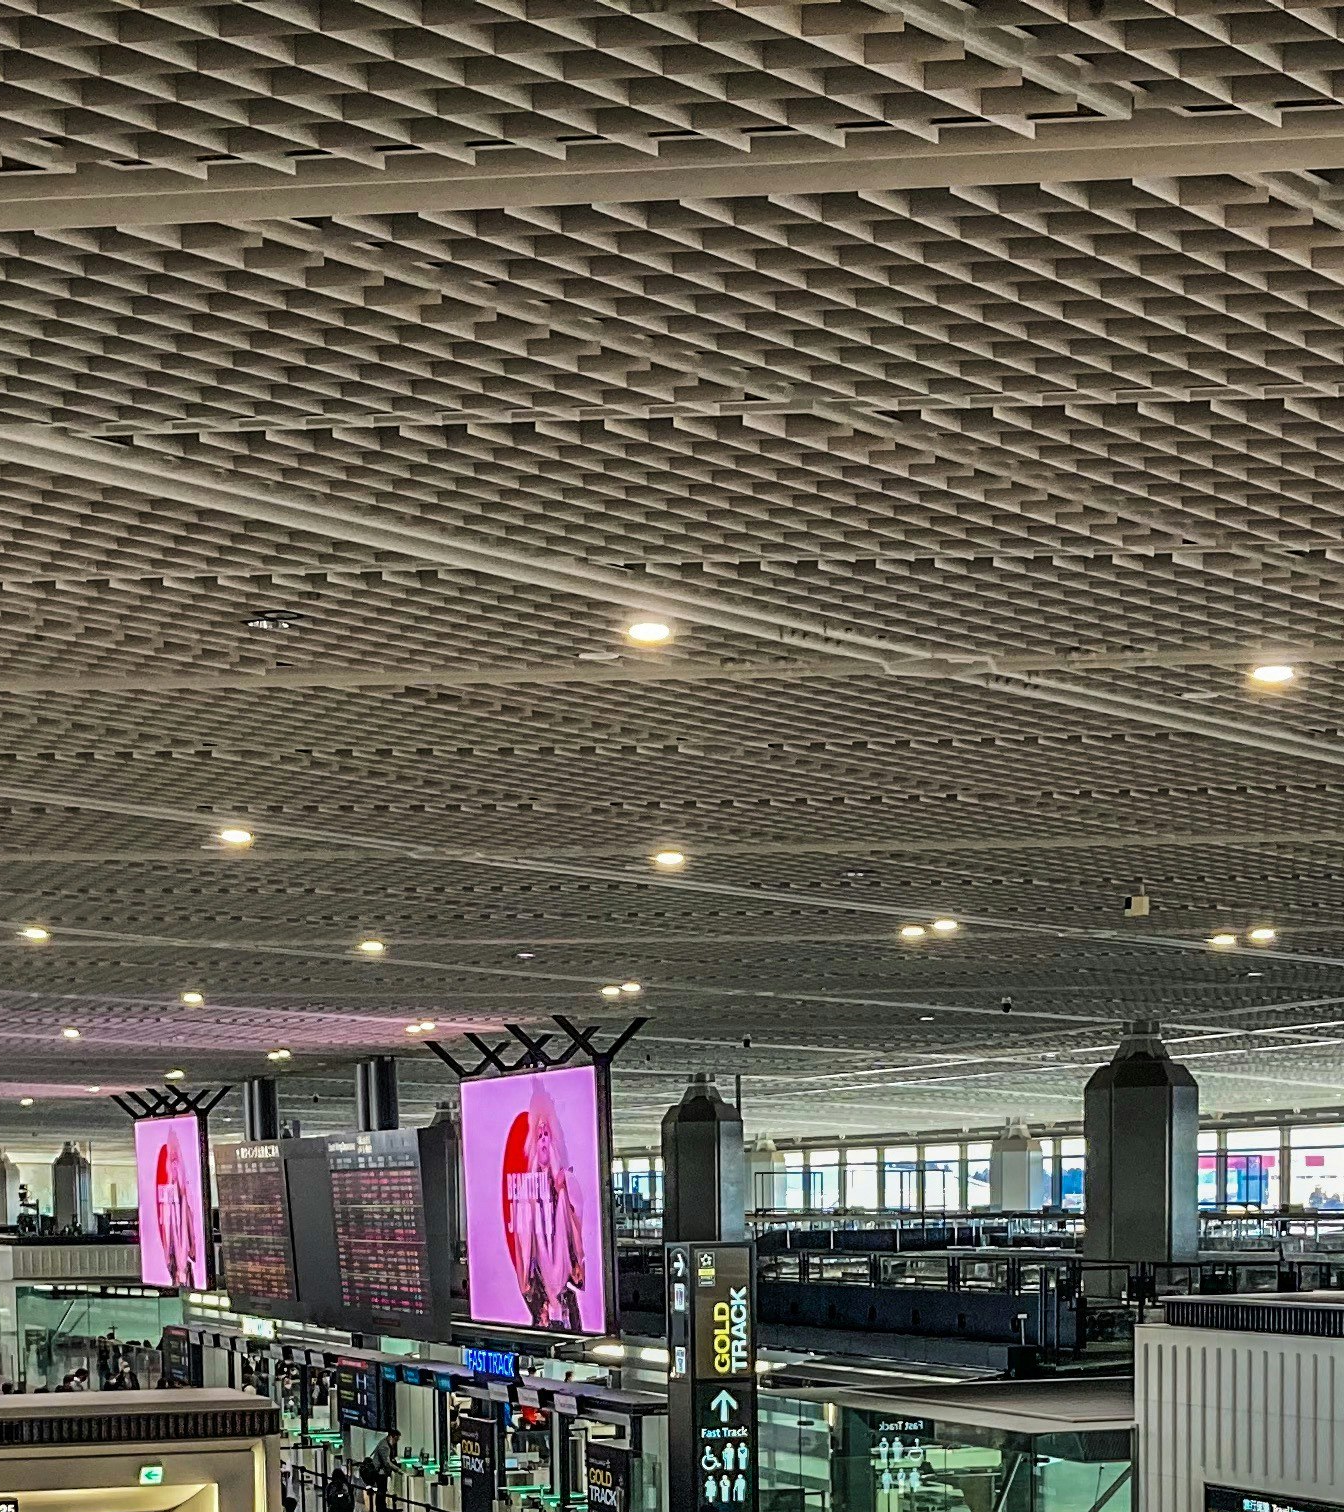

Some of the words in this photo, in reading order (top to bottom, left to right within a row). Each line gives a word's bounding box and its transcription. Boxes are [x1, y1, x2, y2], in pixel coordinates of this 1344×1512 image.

[714, 1302, 731, 1374] GOLD
[730, 1286, 748, 1374] TRACK
[468, 1350, 487, 1373] FAST
[488, 1352, 515, 1377] TRACK
[701, 1428, 720, 1438] Fast
[722, 1426, 748, 1438] Track
[461, 1439, 481, 1456] GOLD
[462, 1455, 485, 1474] TRACK
[589, 1467, 612, 1488] GOLD
[589, 1485, 617, 1507] TRACK
